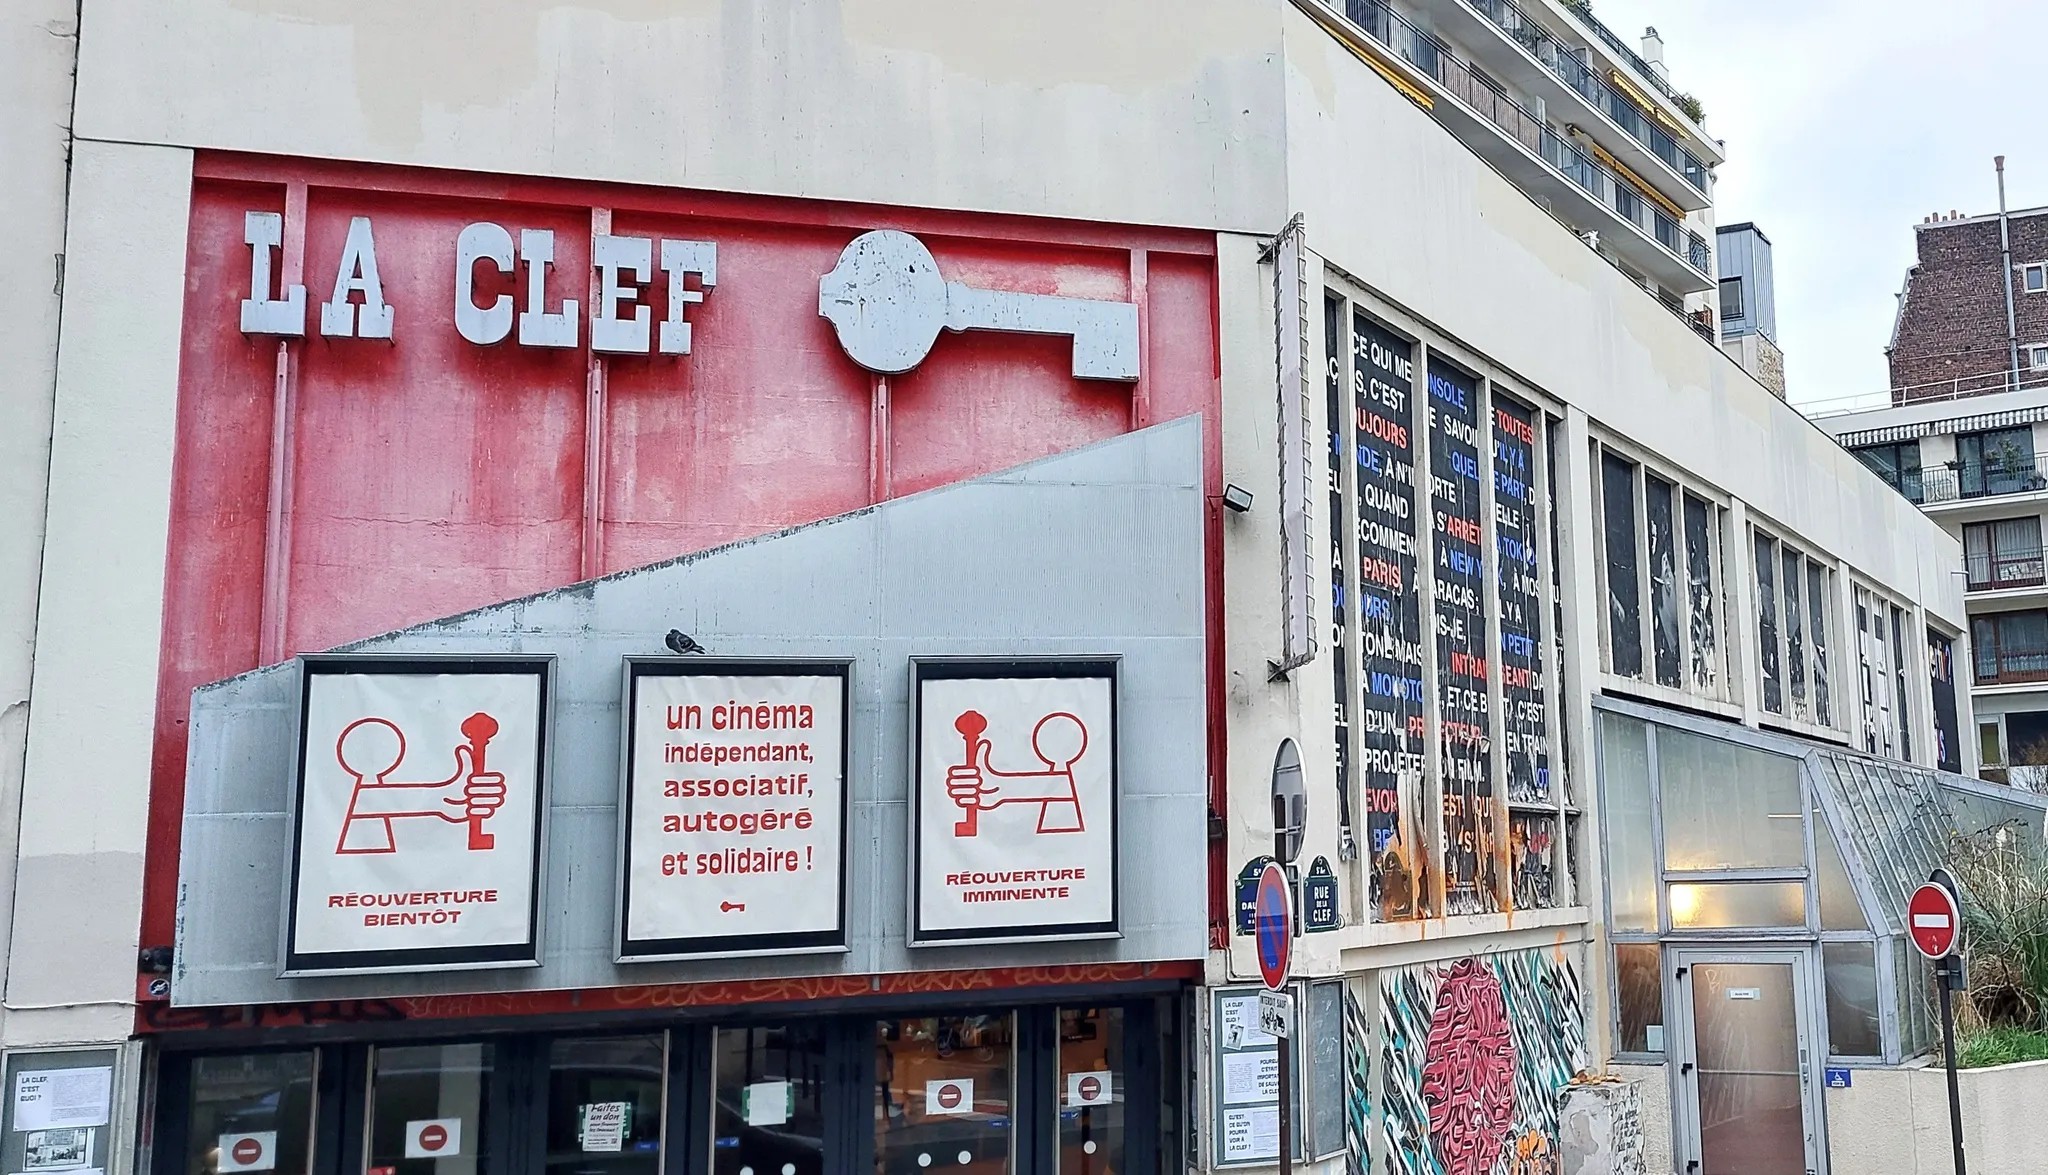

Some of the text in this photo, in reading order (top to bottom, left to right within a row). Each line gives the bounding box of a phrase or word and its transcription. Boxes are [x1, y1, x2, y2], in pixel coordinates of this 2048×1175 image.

[240, 210, 718, 355] LA CLEF
[1371, 342, 1392, 373] QUI
[1394, 354, 1412, 383] ME
[1428, 373, 1468, 415] NSOLE,
[1496, 409, 1534, 445] TOUTES
[1370, 378, 1405, 413] C'EST
[1444, 414, 1479, 449] SAVOI
[1355, 406, 1407, 449] UJOURS
[1500, 474, 1528, 506] PART,
[1365, 483, 1409, 519] QUAND
[1437, 510, 1482, 546] S'ARRÊT
[1440, 540, 1448, 568] À
[1450, 549, 1474, 576] NEW
[1333, 540, 1342, 570] À
[1434, 579, 1479, 615] ARACAS;
[1452, 651, 1487, 680] INTRA
[666, 700, 814, 730] un cinéma
[1518, 699, 1544, 723] C'EST
[664, 741, 814, 767] indépendant,
[663, 774, 814, 798] associatif,
[662, 807, 813, 835] autogéré
[661, 851, 689, 876] et
[696, 847, 799, 875] solidaire
[946, 868, 1086, 886] RÉOUVERTURE
[327, 890, 498, 908] RÉOUVERTURE
[963, 886, 1069, 903] IMMINENTE
[1314, 886, 1330, 900] RUE
[363, 909, 462, 927] BIENTÔT
[1312, 909, 1332, 922] CLEF
[603, 1112, 620, 1121] don
